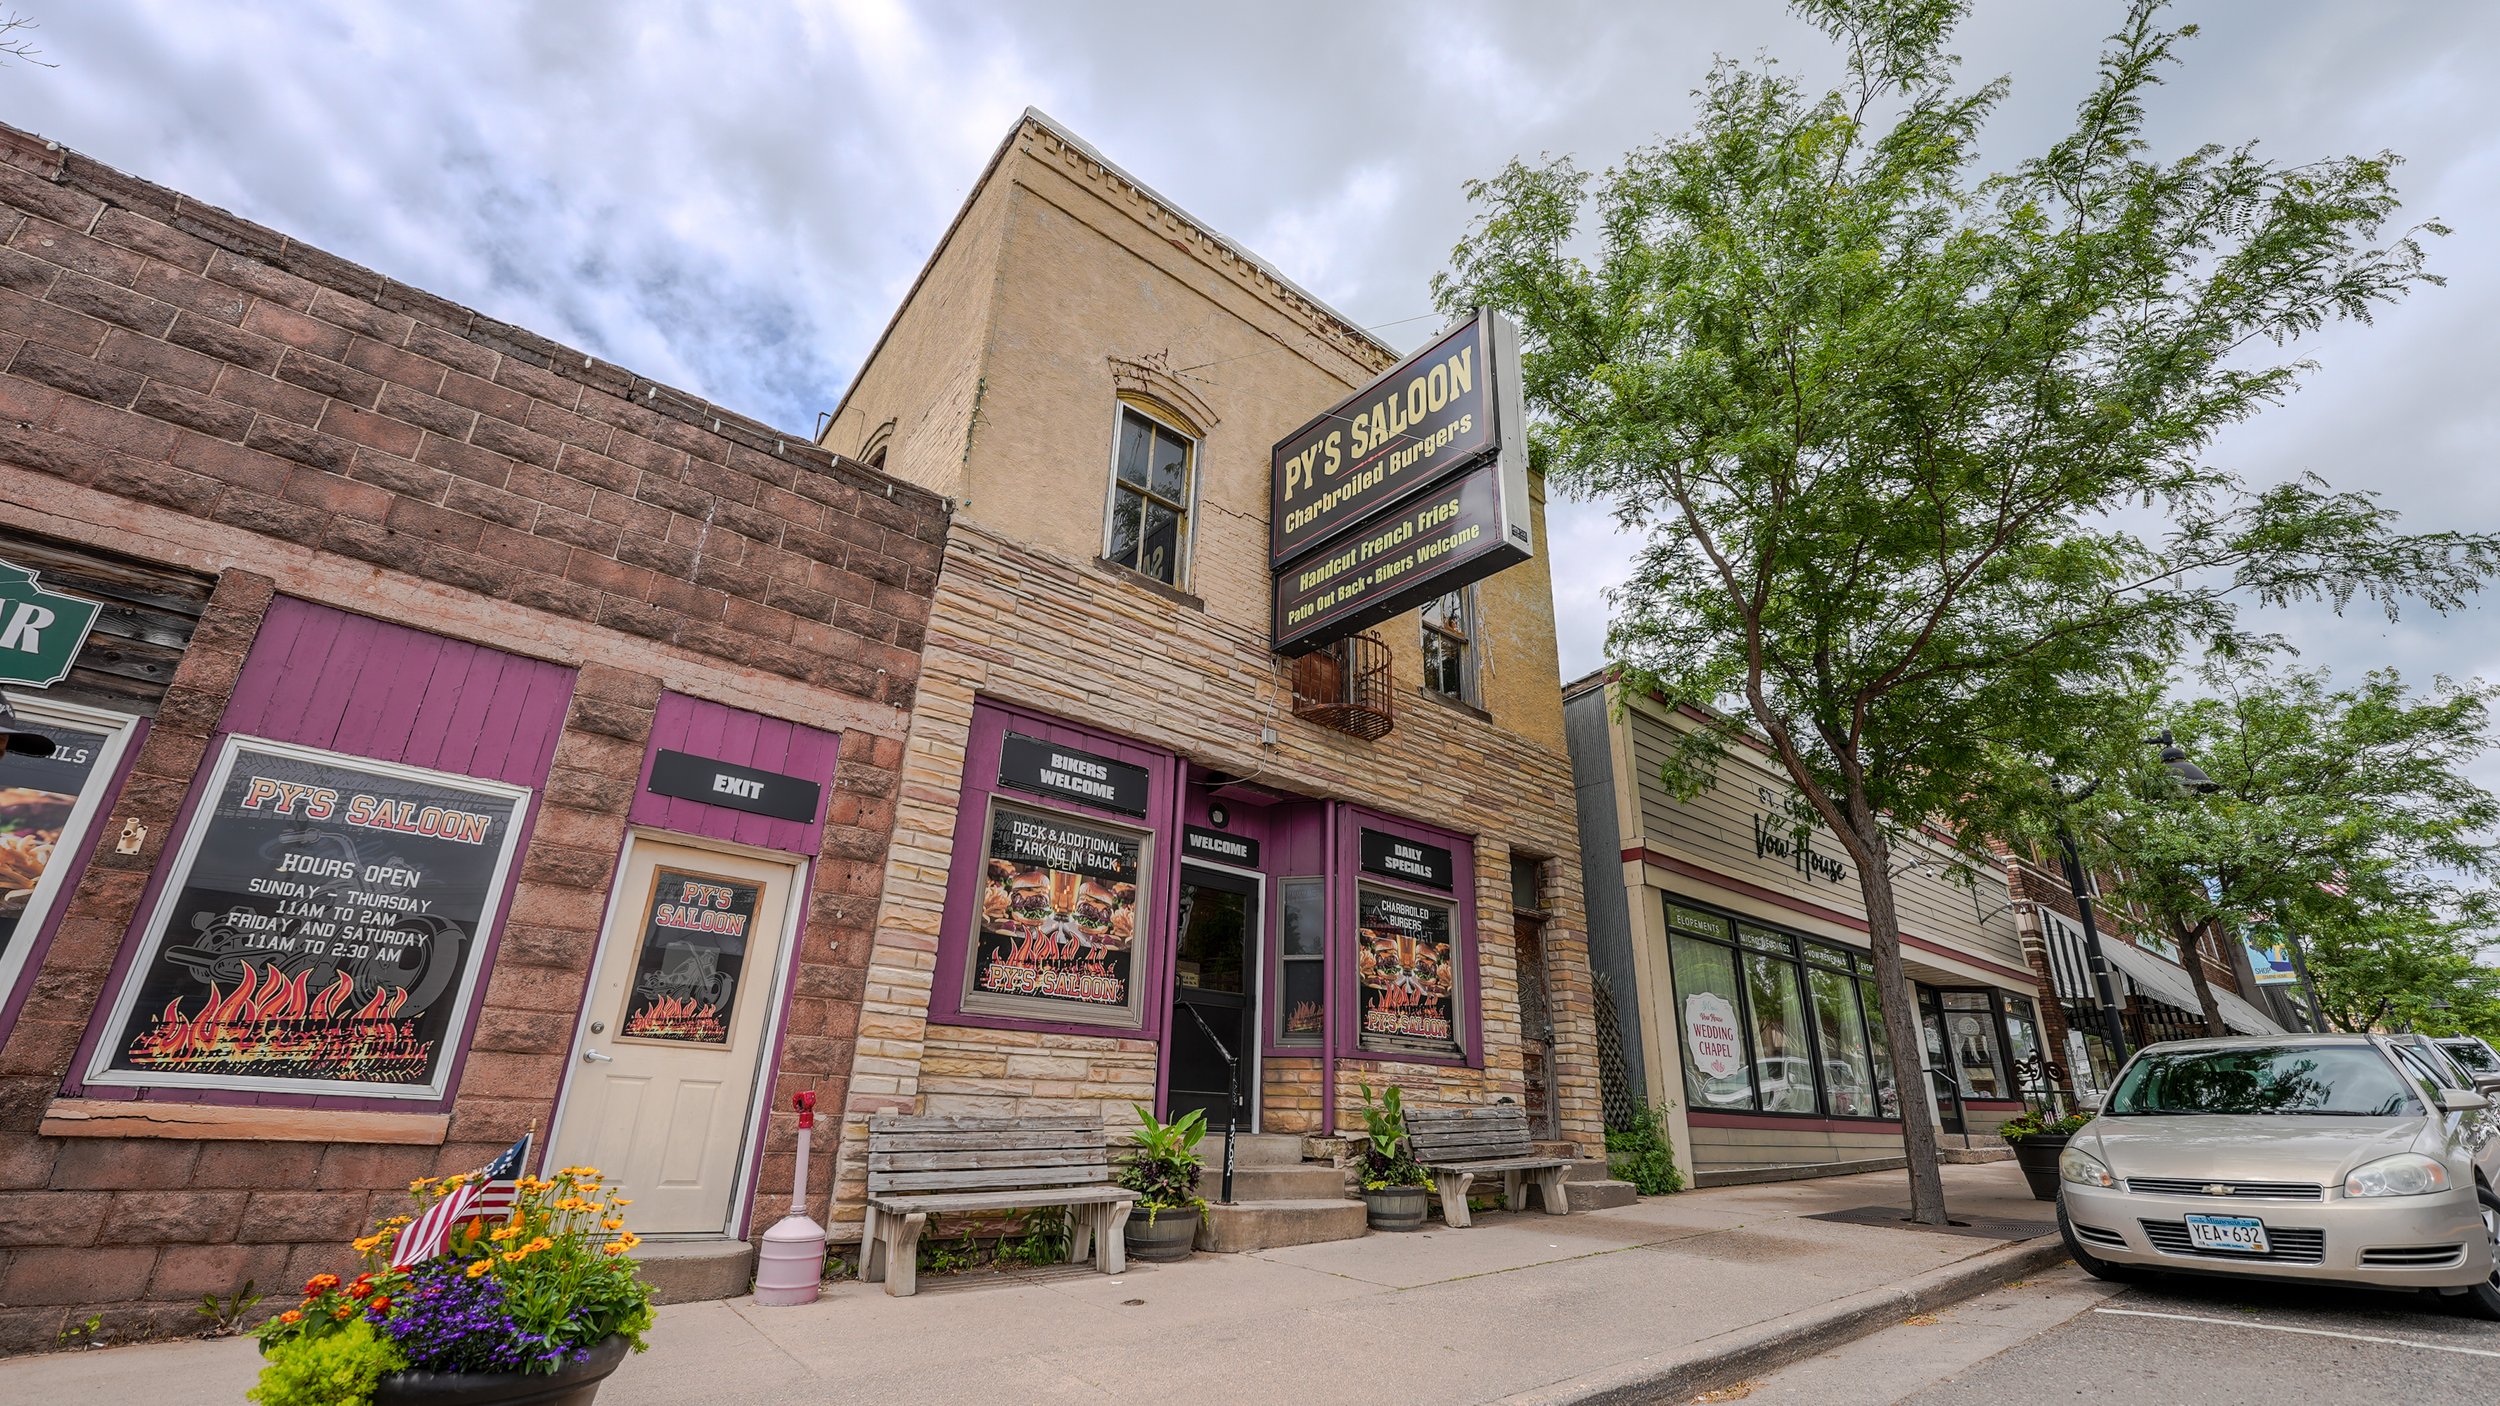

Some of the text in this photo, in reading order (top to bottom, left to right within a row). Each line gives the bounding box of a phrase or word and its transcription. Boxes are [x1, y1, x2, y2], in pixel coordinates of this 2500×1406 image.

[1284, 345, 1472, 502] PY'S SALOON
[1285, 413, 1472, 534] Charbroiled Burgers
[1300, 498, 1460, 592] Handcut French Fries
[1288, 523, 1480, 626] Patio Out Back Bikers Welcome
[0, 597, 55, 654] R
[45, 744, 89, 764] ILS
[1051, 753, 1108, 780] BIKERS
[712, 773, 764, 800] EXIT
[1040, 768, 1115, 800] WELCOME
[241, 776, 492, 845] PY'S SALOON
[1012, 820, 1122, 856] DECK & ADDITIONAL
[1188, 833, 1248, 858] WELCOME
[1754, 812, 1789, 859] Vow
[1791, 826, 1847, 883] House
[1014, 838, 1118, 871] PARKING IN BACK
[1046, 857, 1077, 871] OPEN
[1394, 844, 1422, 861] DAILY
[281, 853, 421, 888] HOURS OPEN
[1385, 856, 1432, 878] SPECIALS
[248, 878, 320, 899] SUNDAY
[347, 890, 432, 913] THURSDAY
[680, 881, 733, 909] PY'S
[275, 900, 397, 926] 11AM TO 2AM
[655, 903, 746, 936] SALOON
[1381, 900, 1429, 919] CHARBROILED
[1389, 915, 1422, 931] BURGERS
[225, 912, 429, 947] FRIDAY AND SATURDAY
[1676, 914, 1720, 934] ELOPEMENTS
[244, 933, 402, 962] 11AM TO 2:30 AM
[1860, 962, 1874, 973] EVEN
[987, 964, 1118, 1002] PY'S SALOON
[1368, 1011, 1447, 1038] PY'S SALOON
[1693, 1023, 1733, 1041] WEDDING
[1699, 1041, 1732, 1057] CHAPEL
[2192, 1224, 2262, 1244] YEA 632
